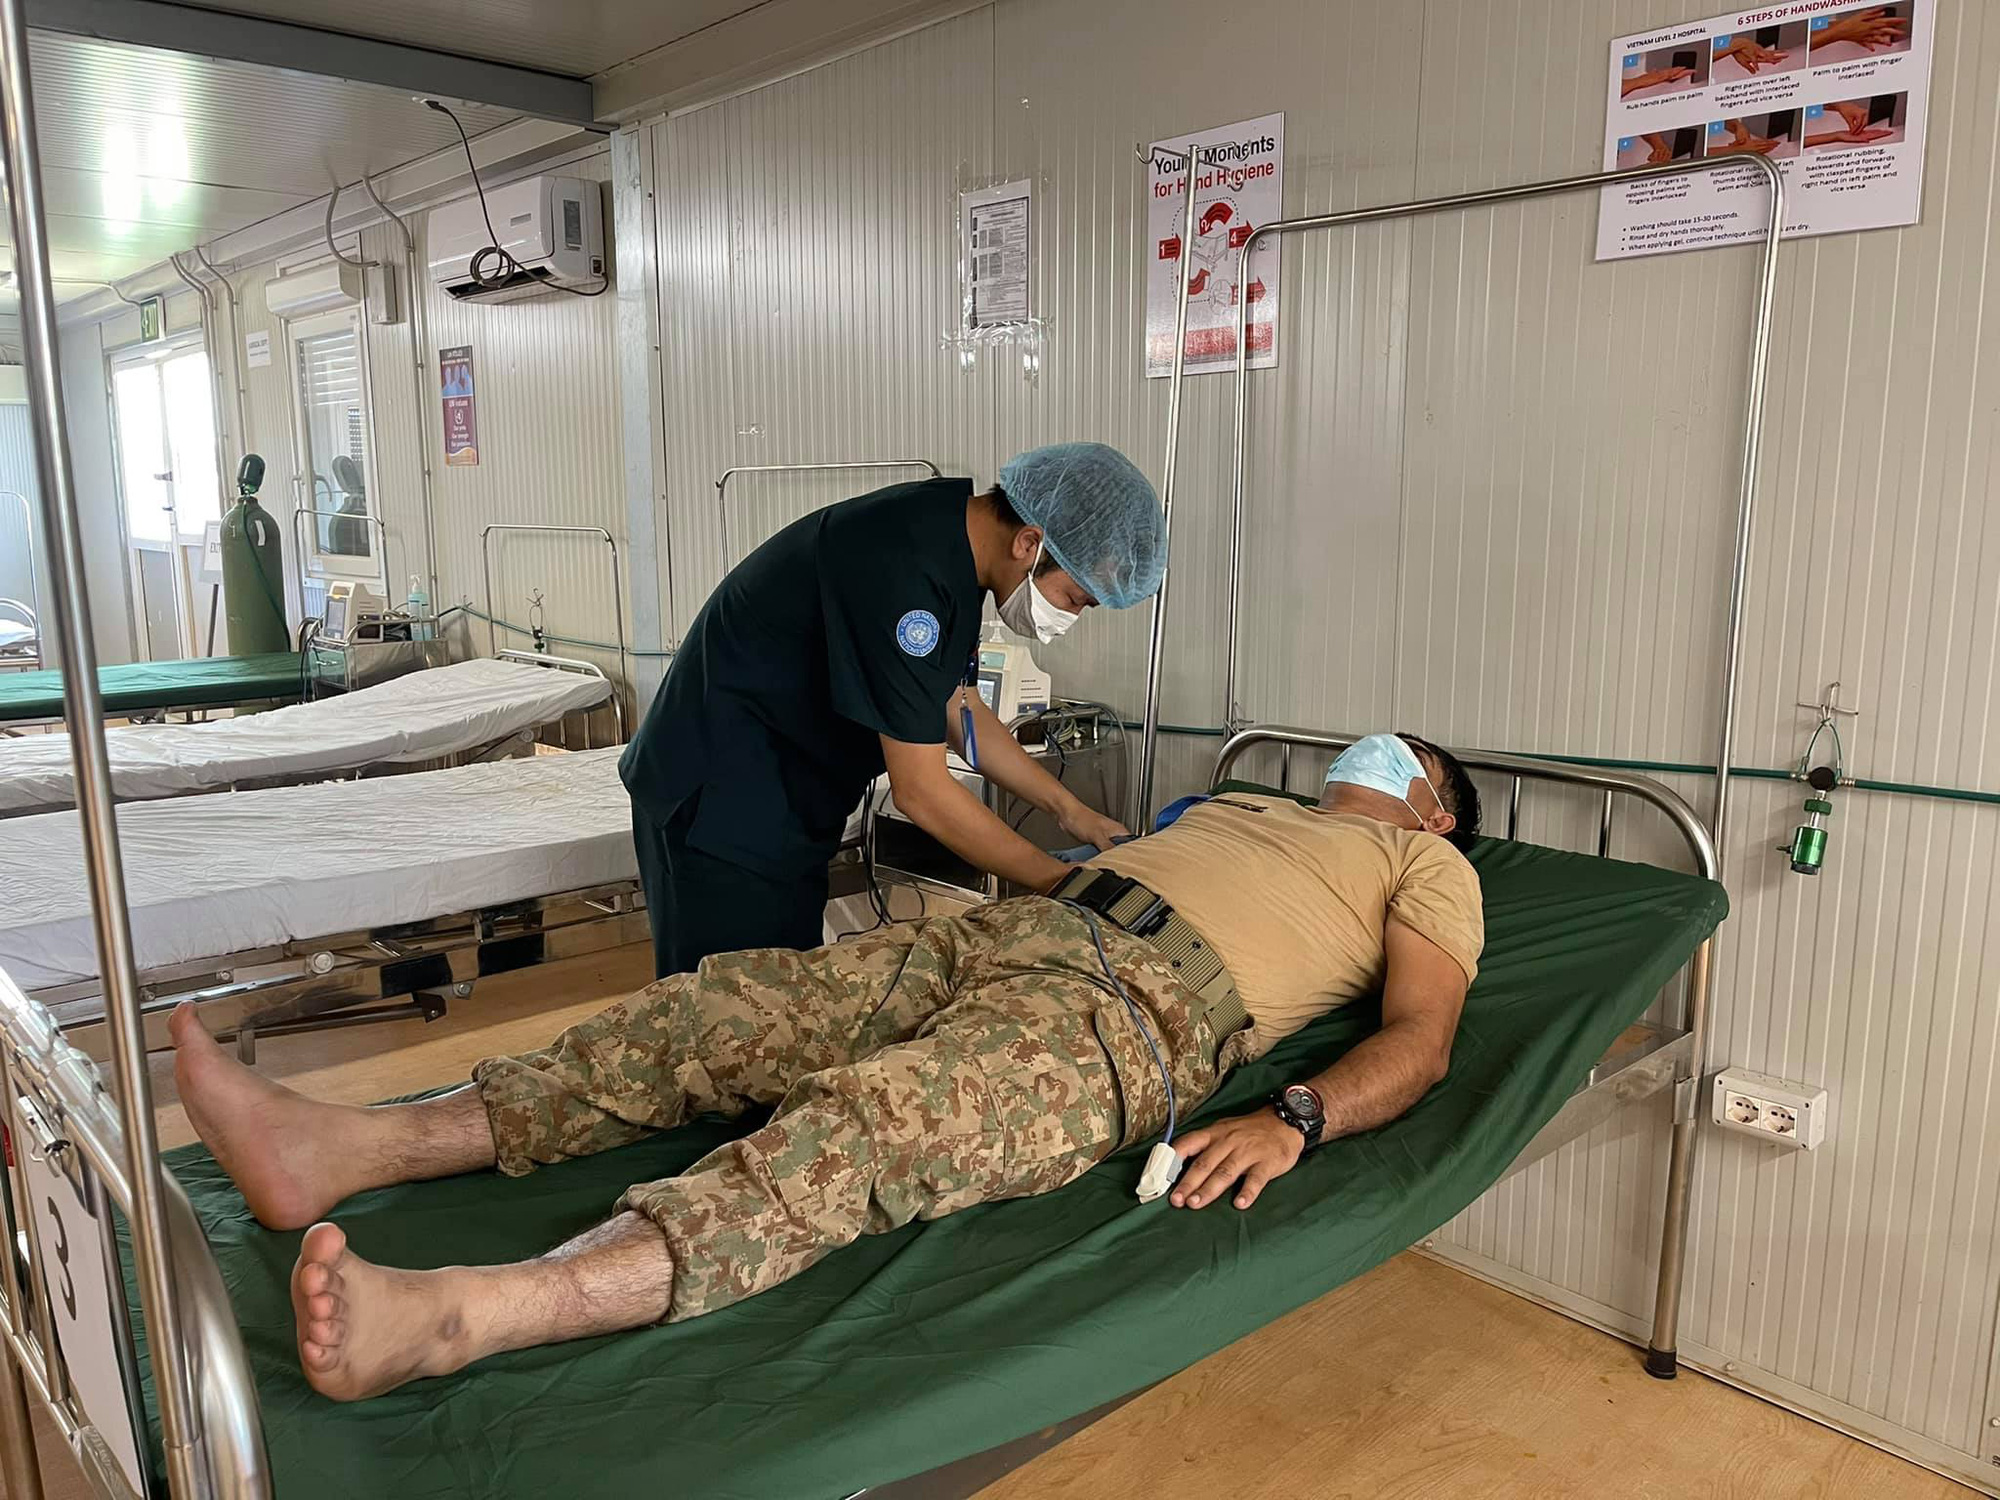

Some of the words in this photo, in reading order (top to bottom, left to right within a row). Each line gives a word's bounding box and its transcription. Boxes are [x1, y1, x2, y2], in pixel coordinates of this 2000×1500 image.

[1737, 17, 1744, 26] 6
[1745, 10, 1773, 25] STEPS
[1775, 8, 1788, 18] OF
[1626, 38, 1654, 49] VIETNAM
[1654, 35, 1672, 43] LEVEL
[1677, 27, 1707, 38] HOSPITAL
[1812, 67, 1831, 77] Palm
[1841, 64, 1860, 74] palm
[1862, 60, 1879, 69] with
[1880, 56, 1903, 68] finger
[1725, 82, 1742, 92] Right
[1743, 80, 1761, 91] palm
[1762, 78, 1778, 86] over
[1779, 75, 1791, 84] left
[1837, 70, 1875, 81] interlaced
[1626, 102, 1639, 110] Rub
[1640, 99, 1659, 108] hands
[1661, 95, 1677, 105] palm
[1686, 91, 1704, 100] palm
[1714, 91, 1748, 102] backhand
[1749, 87, 1764, 96] with
[1765, 82, 1800, 93] interlaced
[1720, 98, 1743, 109] fingers
[1744, 97, 1758, 105] and
[1759, 94, 1773, 103] vice
[1774, 92, 1793, 100] versa
[1203, 136, 1275, 163] Moments
[1816, 152, 1852, 162] Rotational
[1805, 163, 1844, 171] backwards
[1862, 155, 1895, 163] forwards
[1826, 169, 1854, 177] clasped
[1855, 166, 1880, 175] fingers
[1710, 168, 1744, 177] Rotational
[1801, 181, 1818, 189] right
[1862, 173, 1881, 181] palm
[1154, 181, 1173, 198] for
[1177, 173, 1212, 194] Hnd
[1656, 186, 1675, 194] palms
[1657, 178, 1679, 187] fingers
[1717, 184, 1736, 192] palm
[1628, 197, 1650, 205] fingers
[1629, 222, 1656, 232] Washing
[1656, 219, 1677, 228] should
[1678, 217, 1692, 225] take
[1693, 214, 1711, 223] 15-30
[1160, 243, 1165, 254] 1
[1230, 231, 1237, 244] 4
[1628, 242, 1646, 251] When
[1647, 239, 1673, 249] applying
[1685, 234, 1713, 244] continue
[1714, 231, 1747, 242] technique
[1747, 228, 1763, 236] until
[1629, 233, 1649, 242] Rinse
[1649, 231, 1658, 239] and
[1658, 230, 1669, 240] dry
[1670, 227, 1689, 236] hands
[47, 1195, 77, 1321] 3
